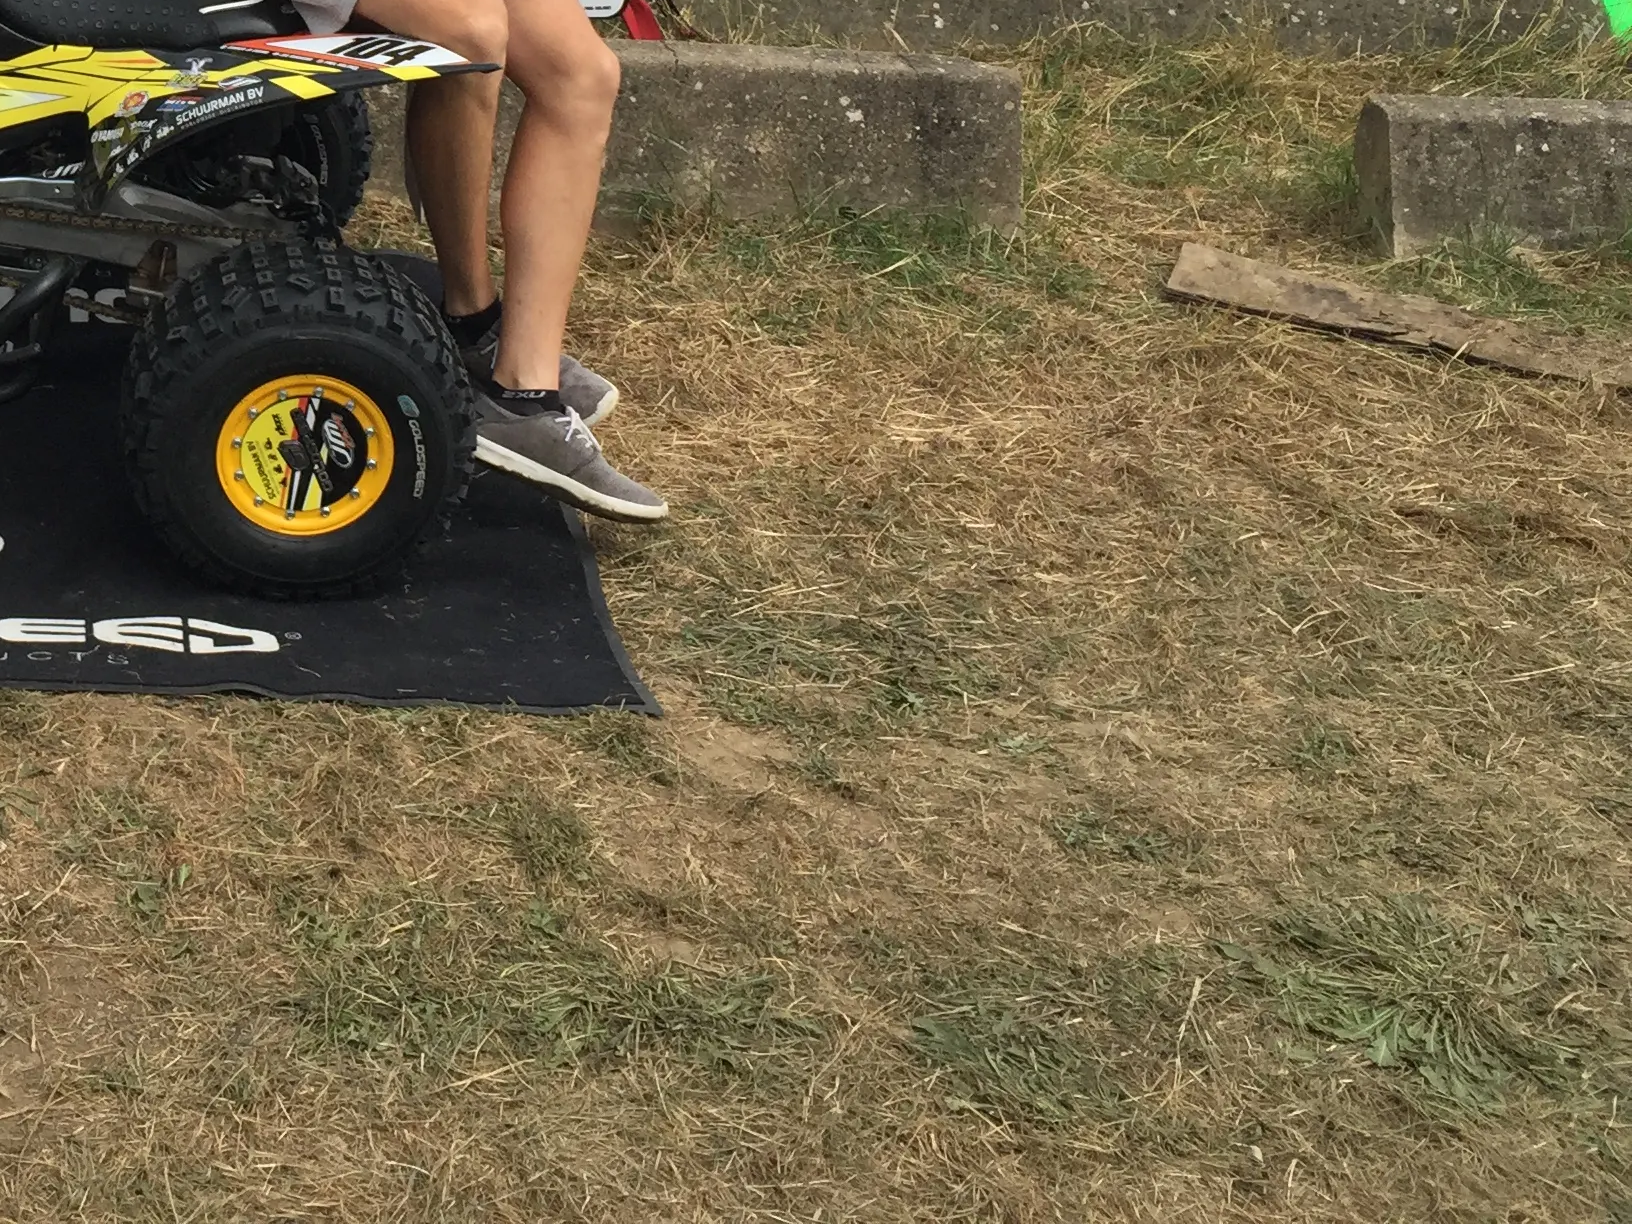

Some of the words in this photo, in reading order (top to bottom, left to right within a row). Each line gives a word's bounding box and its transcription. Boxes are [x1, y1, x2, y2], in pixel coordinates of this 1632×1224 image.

[327, 36, 436, 66] 104
[175, 93, 244, 126] SCHUURMAN
[246, 86, 265, 100] BV
[408, 419, 428, 499] GOLDSPEED
